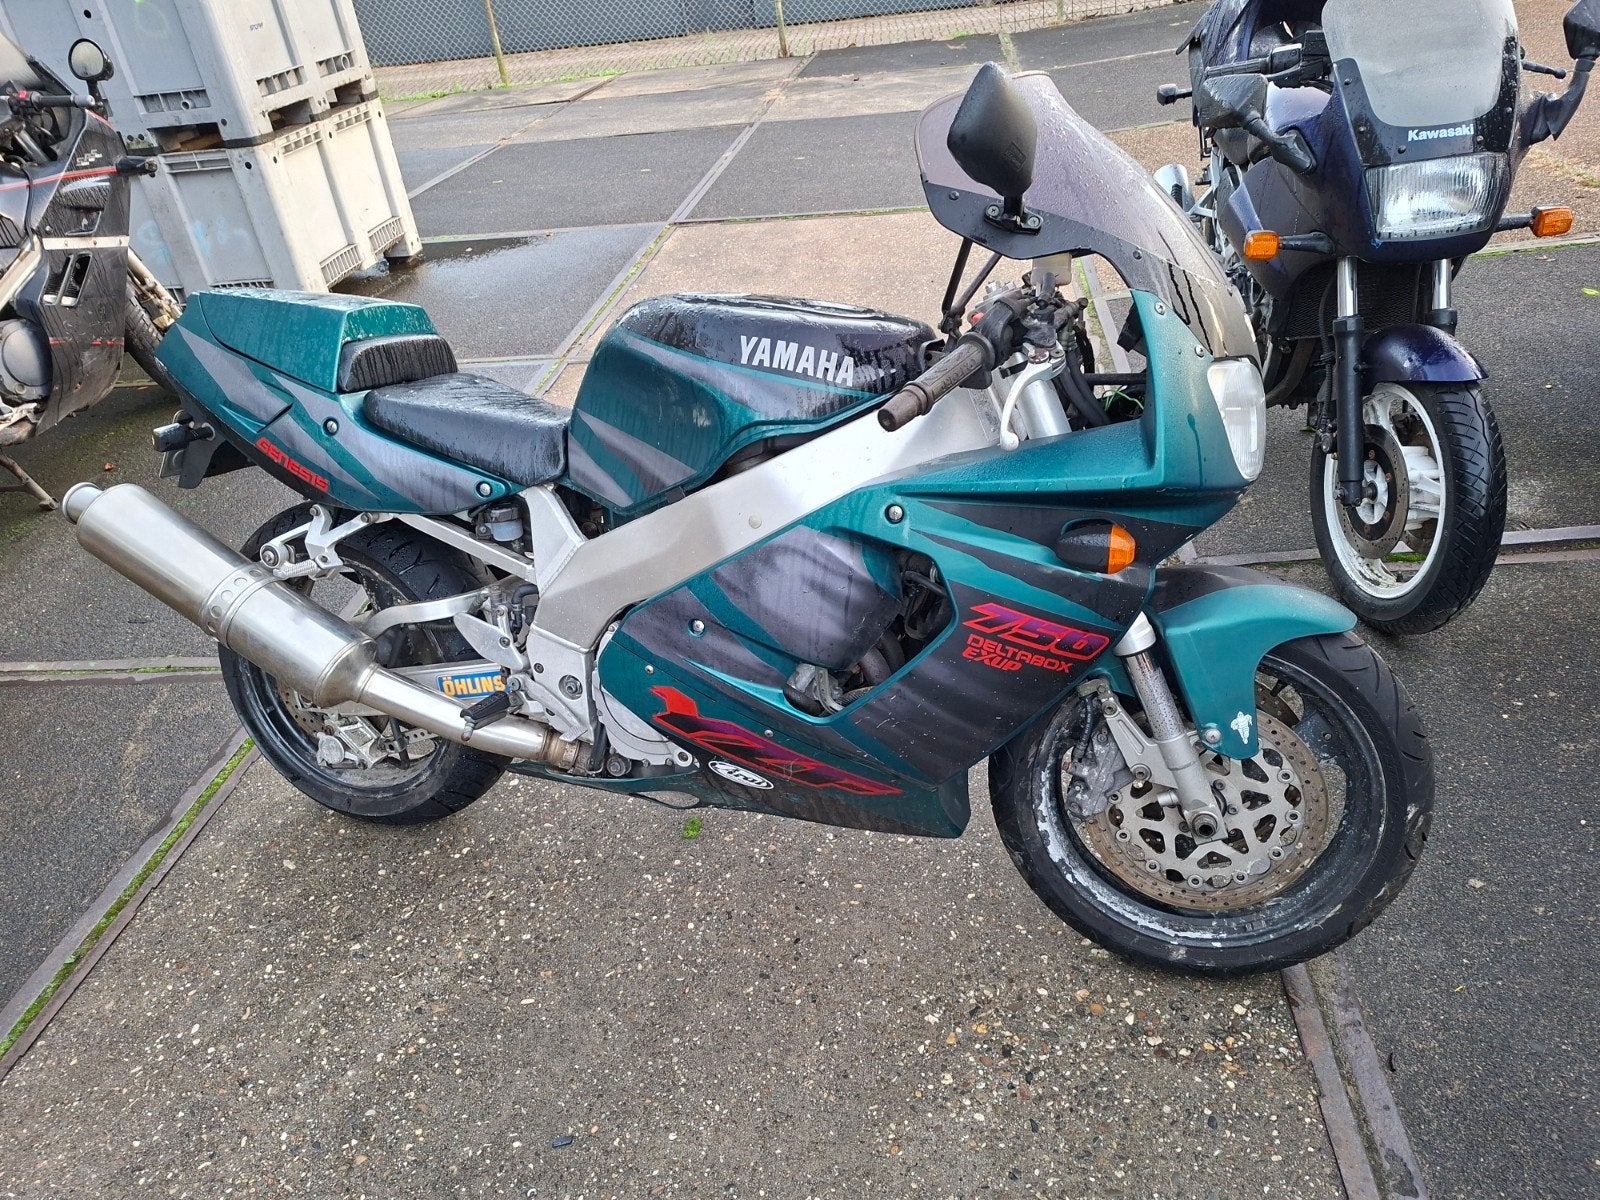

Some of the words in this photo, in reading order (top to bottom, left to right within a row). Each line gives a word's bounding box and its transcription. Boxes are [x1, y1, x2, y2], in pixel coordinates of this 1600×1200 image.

[1407, 123, 1475, 142] Kawasaki
[740, 335, 854, 387] YAMAHA
[256, 437, 329, 492] GENESIS
[962, 602, 1110, 661] 750
[962, 646, 1023, 672] EXUP
[967, 633, 1074, 674] DELTABOX
[442, 675, 506, 697] ÖHLINS
